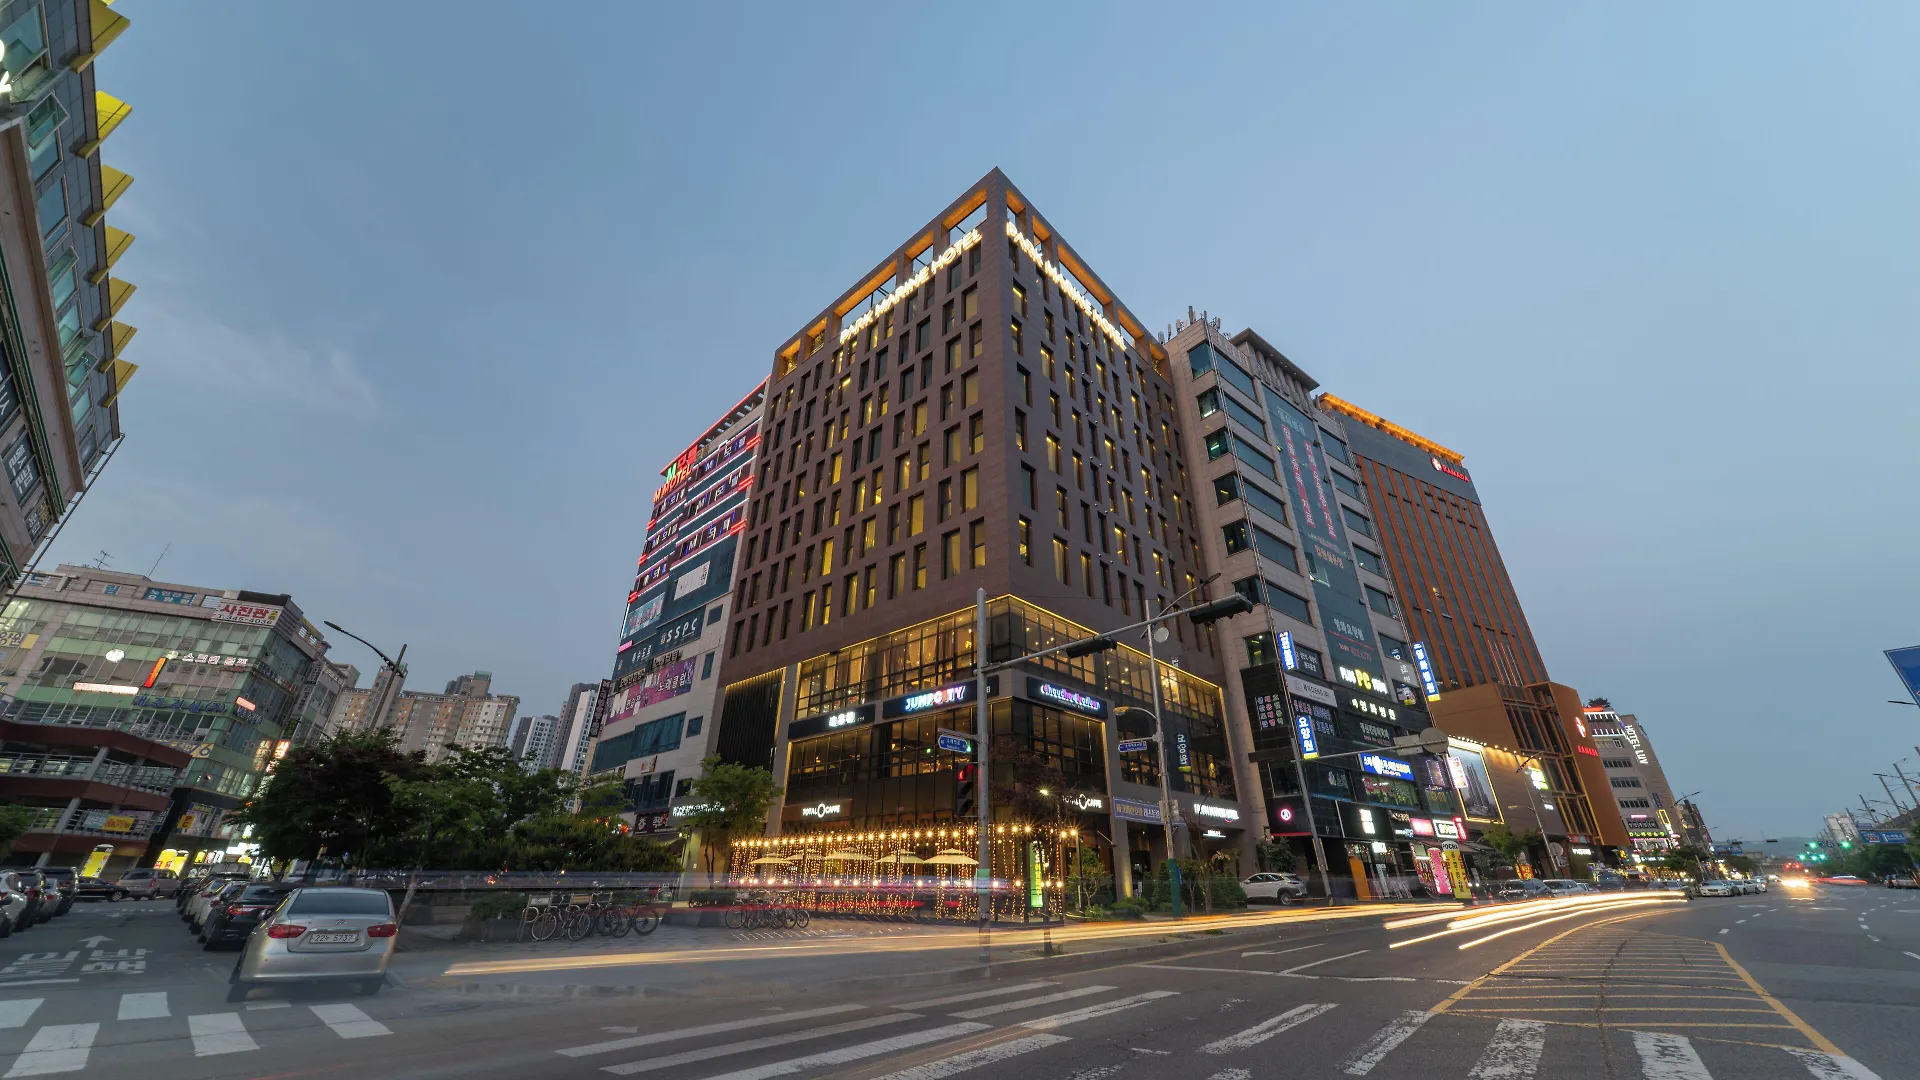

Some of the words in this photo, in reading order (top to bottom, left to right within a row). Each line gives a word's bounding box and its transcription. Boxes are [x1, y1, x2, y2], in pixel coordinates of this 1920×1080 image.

[1005, 220, 1044, 267] PARK
[839, 309, 875, 344] PARK
[874, 268, 931, 319] MARINE
[930, 228, 983, 275] HOTEL
[661, 463, 692, 496] MOTEL
[1441, 464, 1470, 483] RAMADA
[220, 603, 270, 619] 사진관
[666, 618, 699, 643] SSPC
[182, 652, 221, 665] 스크린
[223, 656, 248, 667] 골프
[1355, 668, 1372, 690] PC
[1299, 717, 1315, 752] 요양원
[1625, 724, 1640, 750] HOTEL
[1635, 749, 1649, 765] LUV
